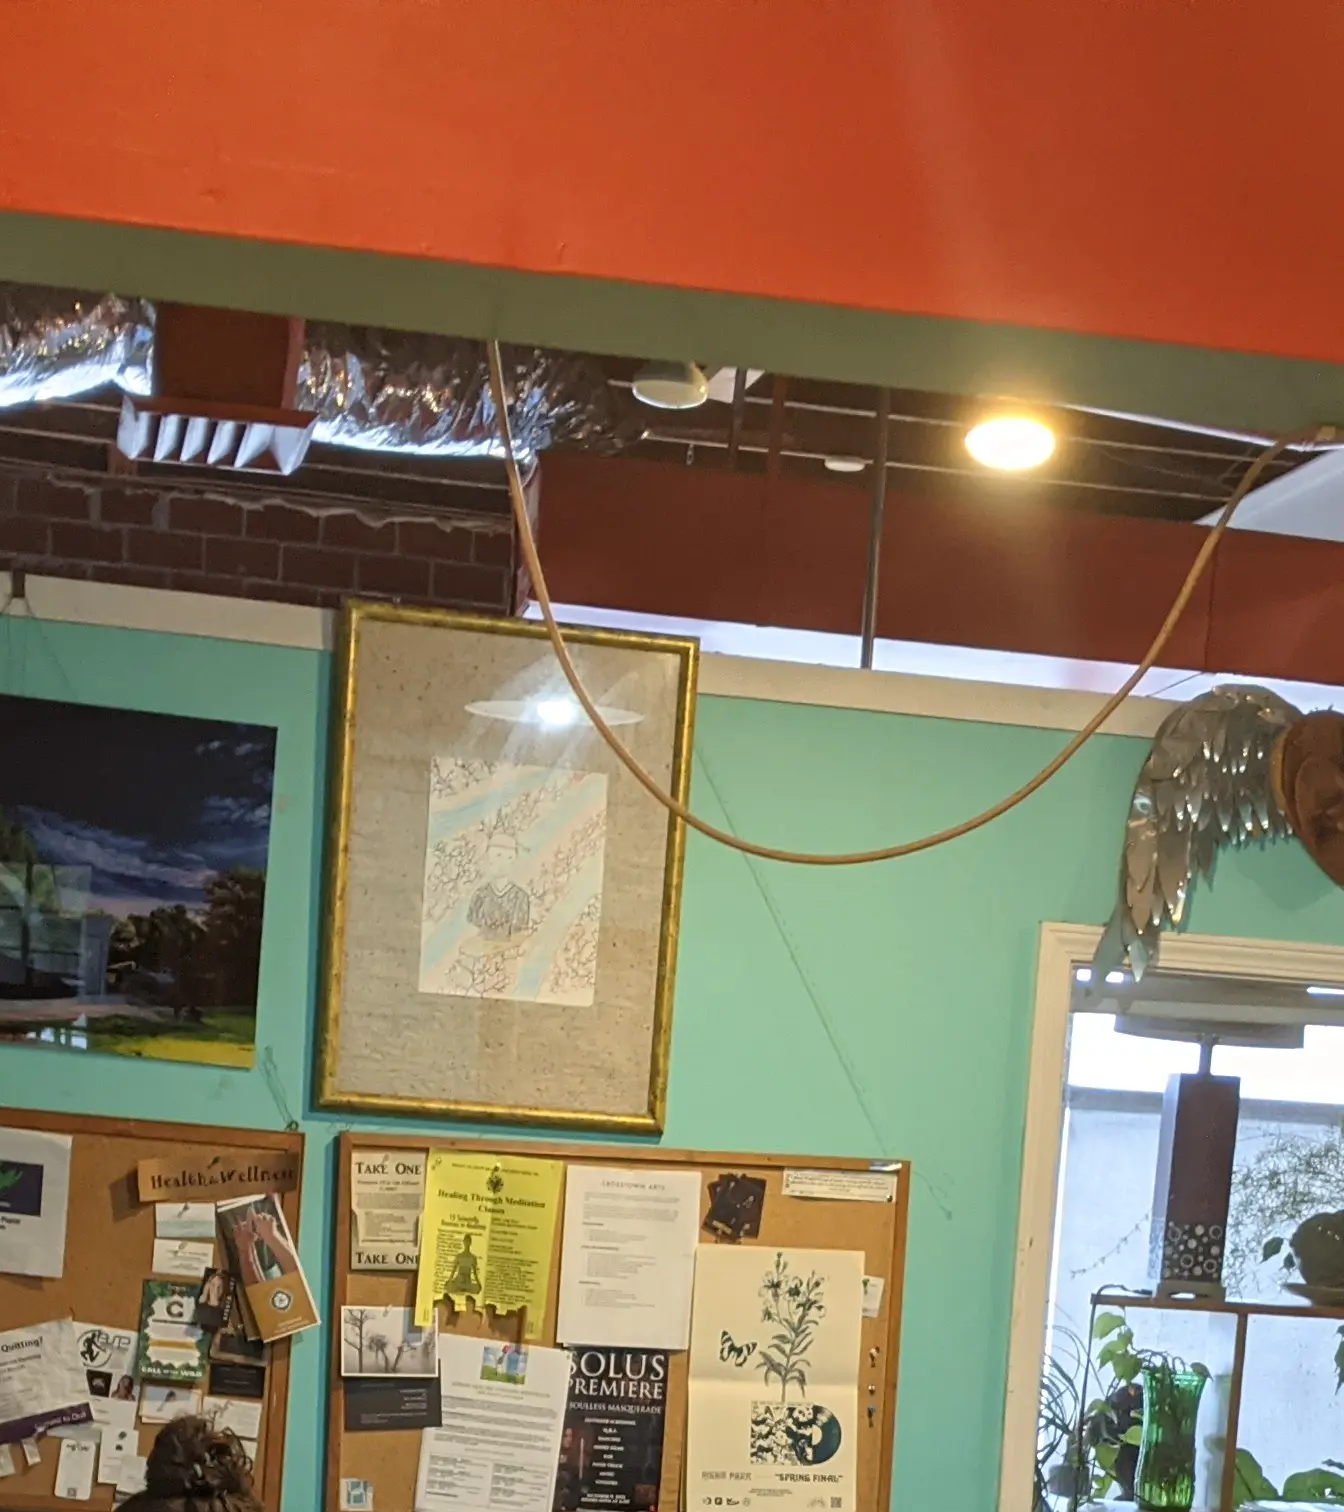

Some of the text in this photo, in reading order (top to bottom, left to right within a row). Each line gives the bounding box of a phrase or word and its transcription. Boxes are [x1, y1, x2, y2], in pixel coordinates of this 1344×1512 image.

[150, 1170, 205, 1190] Health
[219, 1165, 295, 1184] Wellness
[356, 1161, 422, 1176] TAKE ONE
[437, 1188, 546, 1208] Healing Through Meditation
[356, 1252, 389, 1265] TAKE
[570, 1350, 665, 1381] SOLUS
